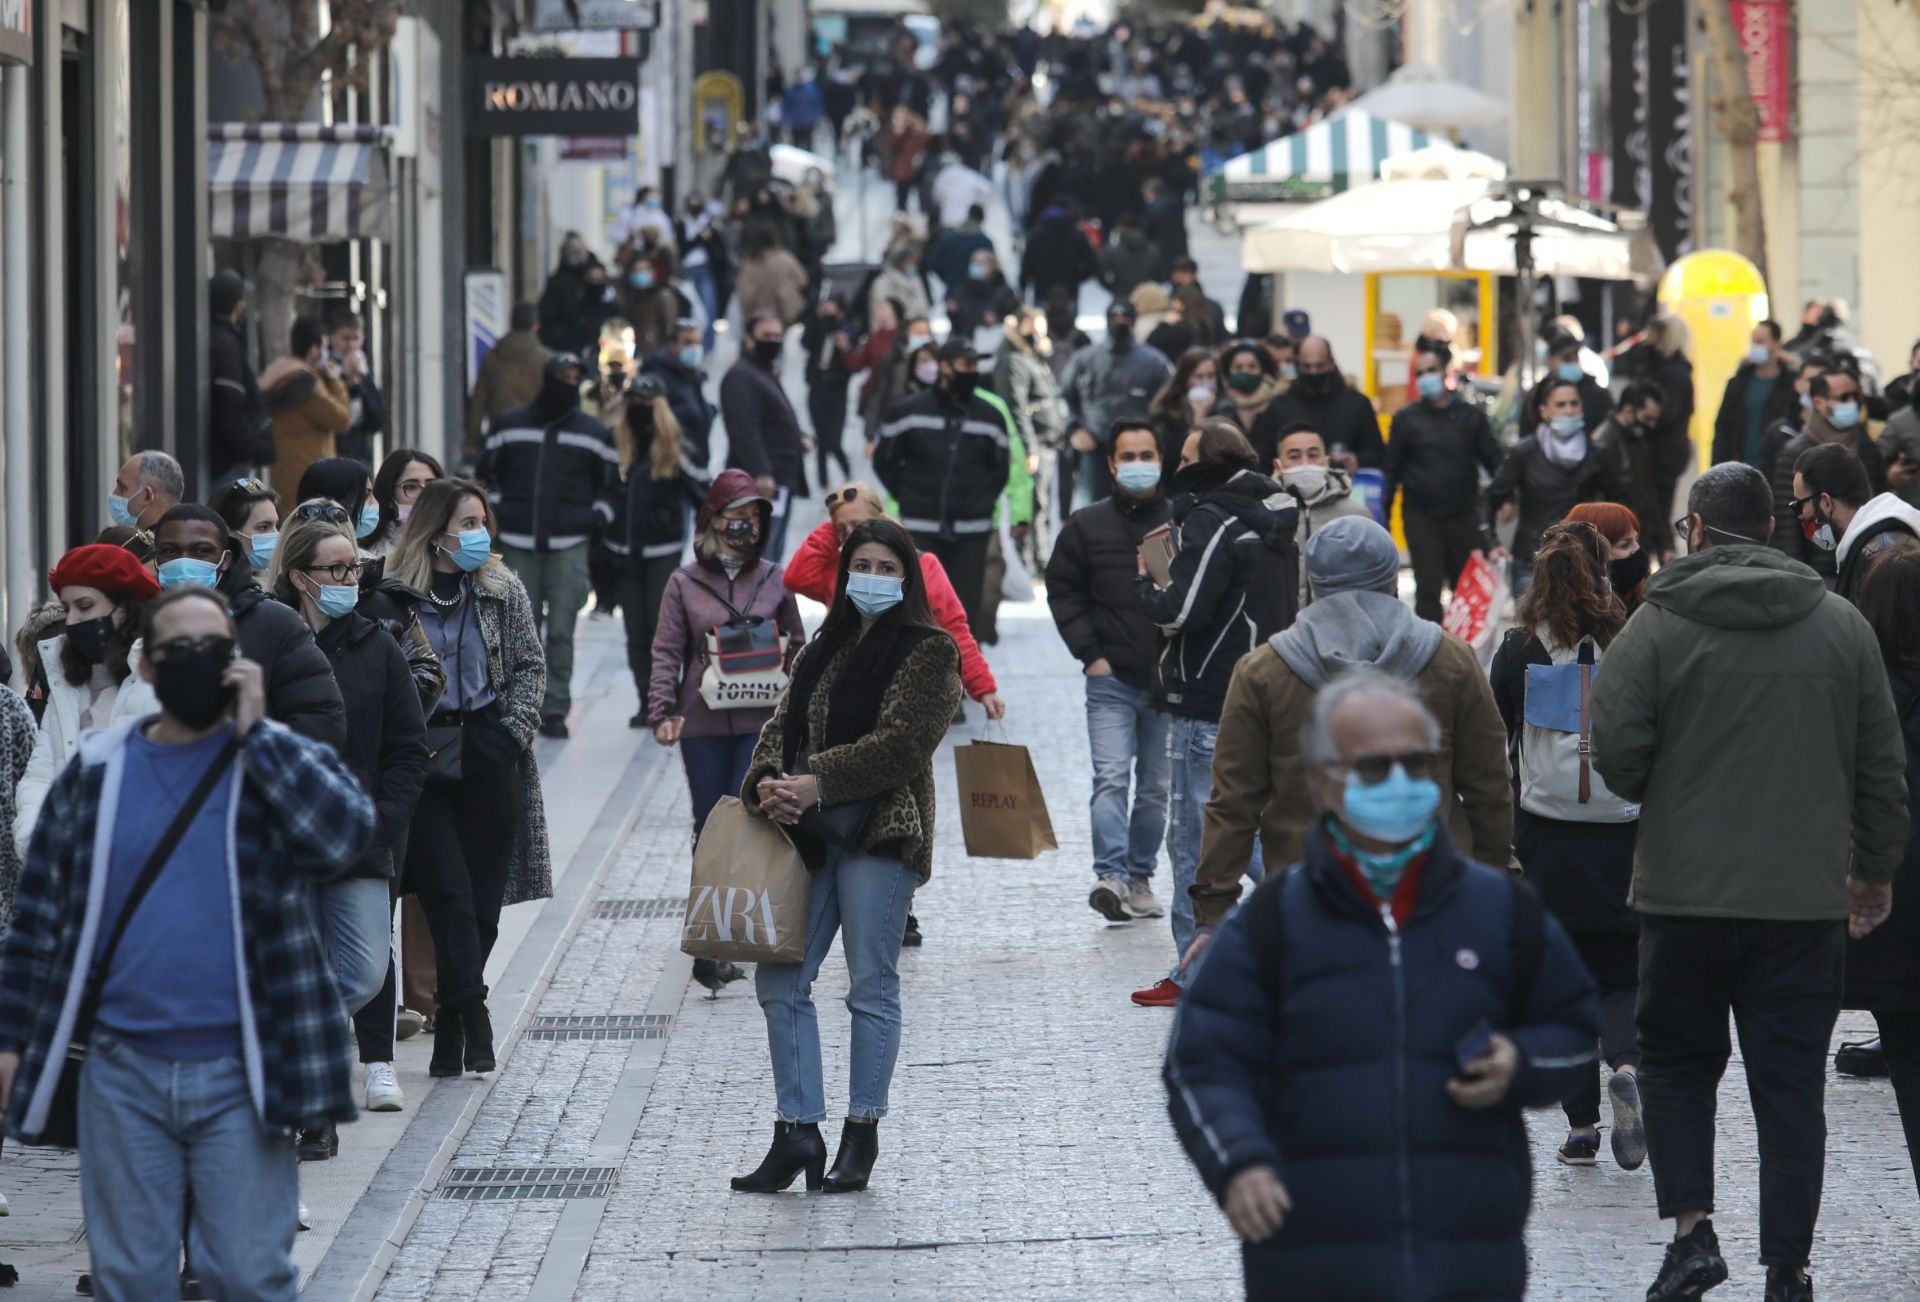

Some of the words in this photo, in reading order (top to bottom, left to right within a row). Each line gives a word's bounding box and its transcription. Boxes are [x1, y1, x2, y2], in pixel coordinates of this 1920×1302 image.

[485, 81, 635, 111] ROMANO
[971, 792, 1017, 809] REPLAY
[682, 885, 778, 945] ZARA
